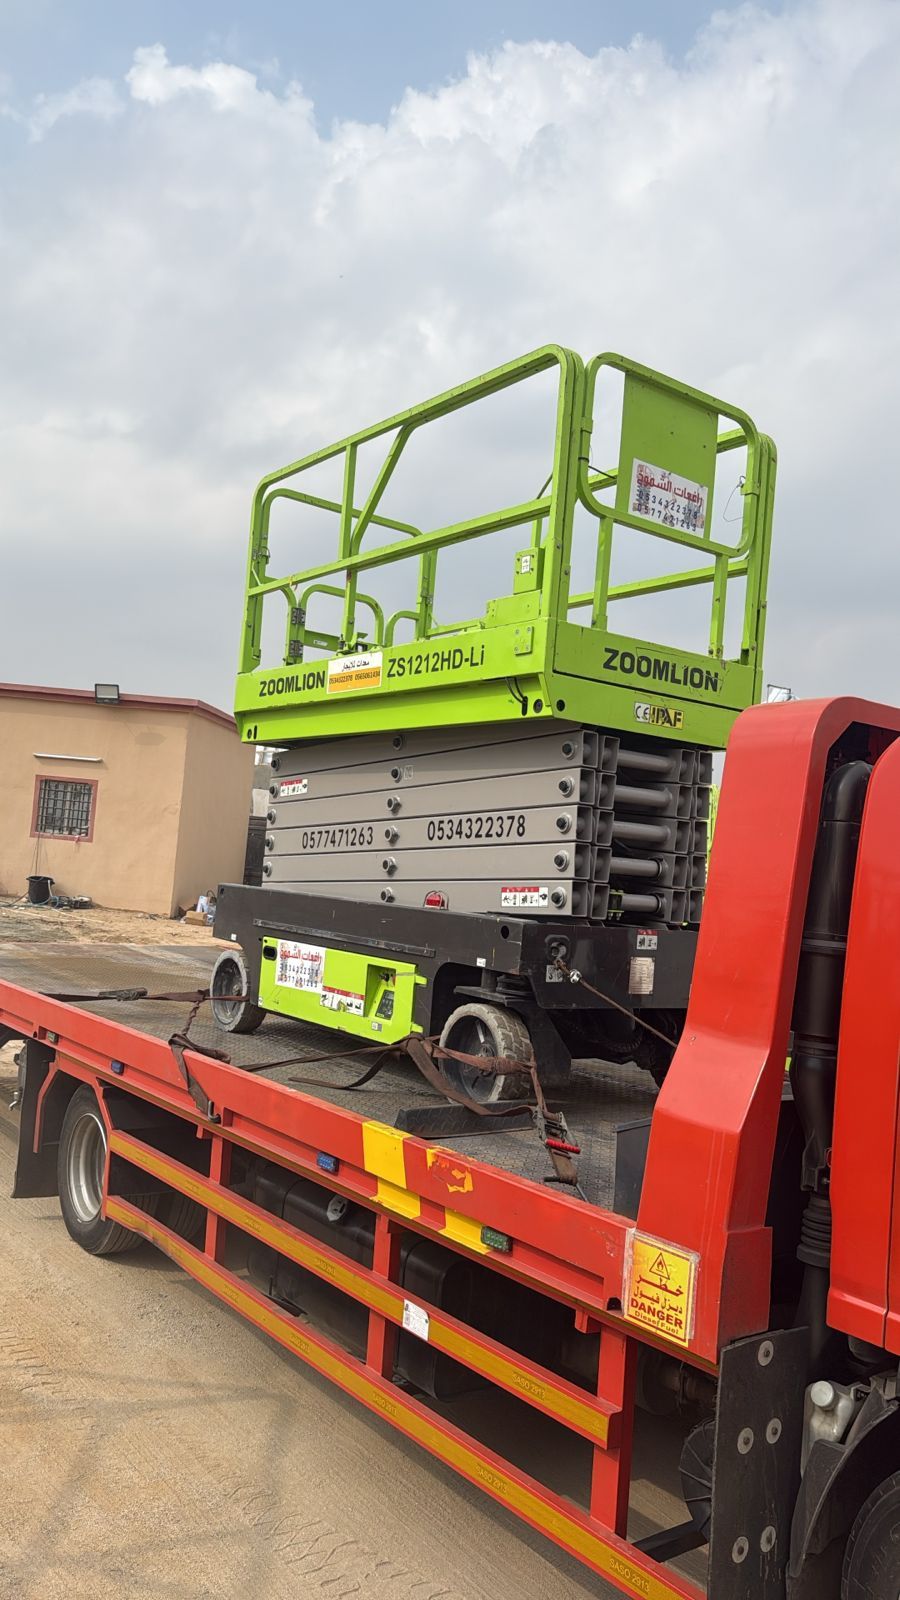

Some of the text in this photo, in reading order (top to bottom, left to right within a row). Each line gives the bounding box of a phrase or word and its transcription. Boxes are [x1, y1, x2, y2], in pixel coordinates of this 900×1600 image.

[387, 645, 485, 678] ZS1212HD-Li
[602, 647, 720, 692] ZOOMLION
[259, 670, 326, 697] ZOOMLION
[302, 815, 526, 849] 0577471263 0534322378
[634, 1287, 660, 1305] فيول
[637, 1275, 683, 1297] خطر
[631, 1298, 683, 1329] DANGER
[634, 1311, 679, 1335] Diesel Fuel
[610, 1559, 631, 1579] SASO
